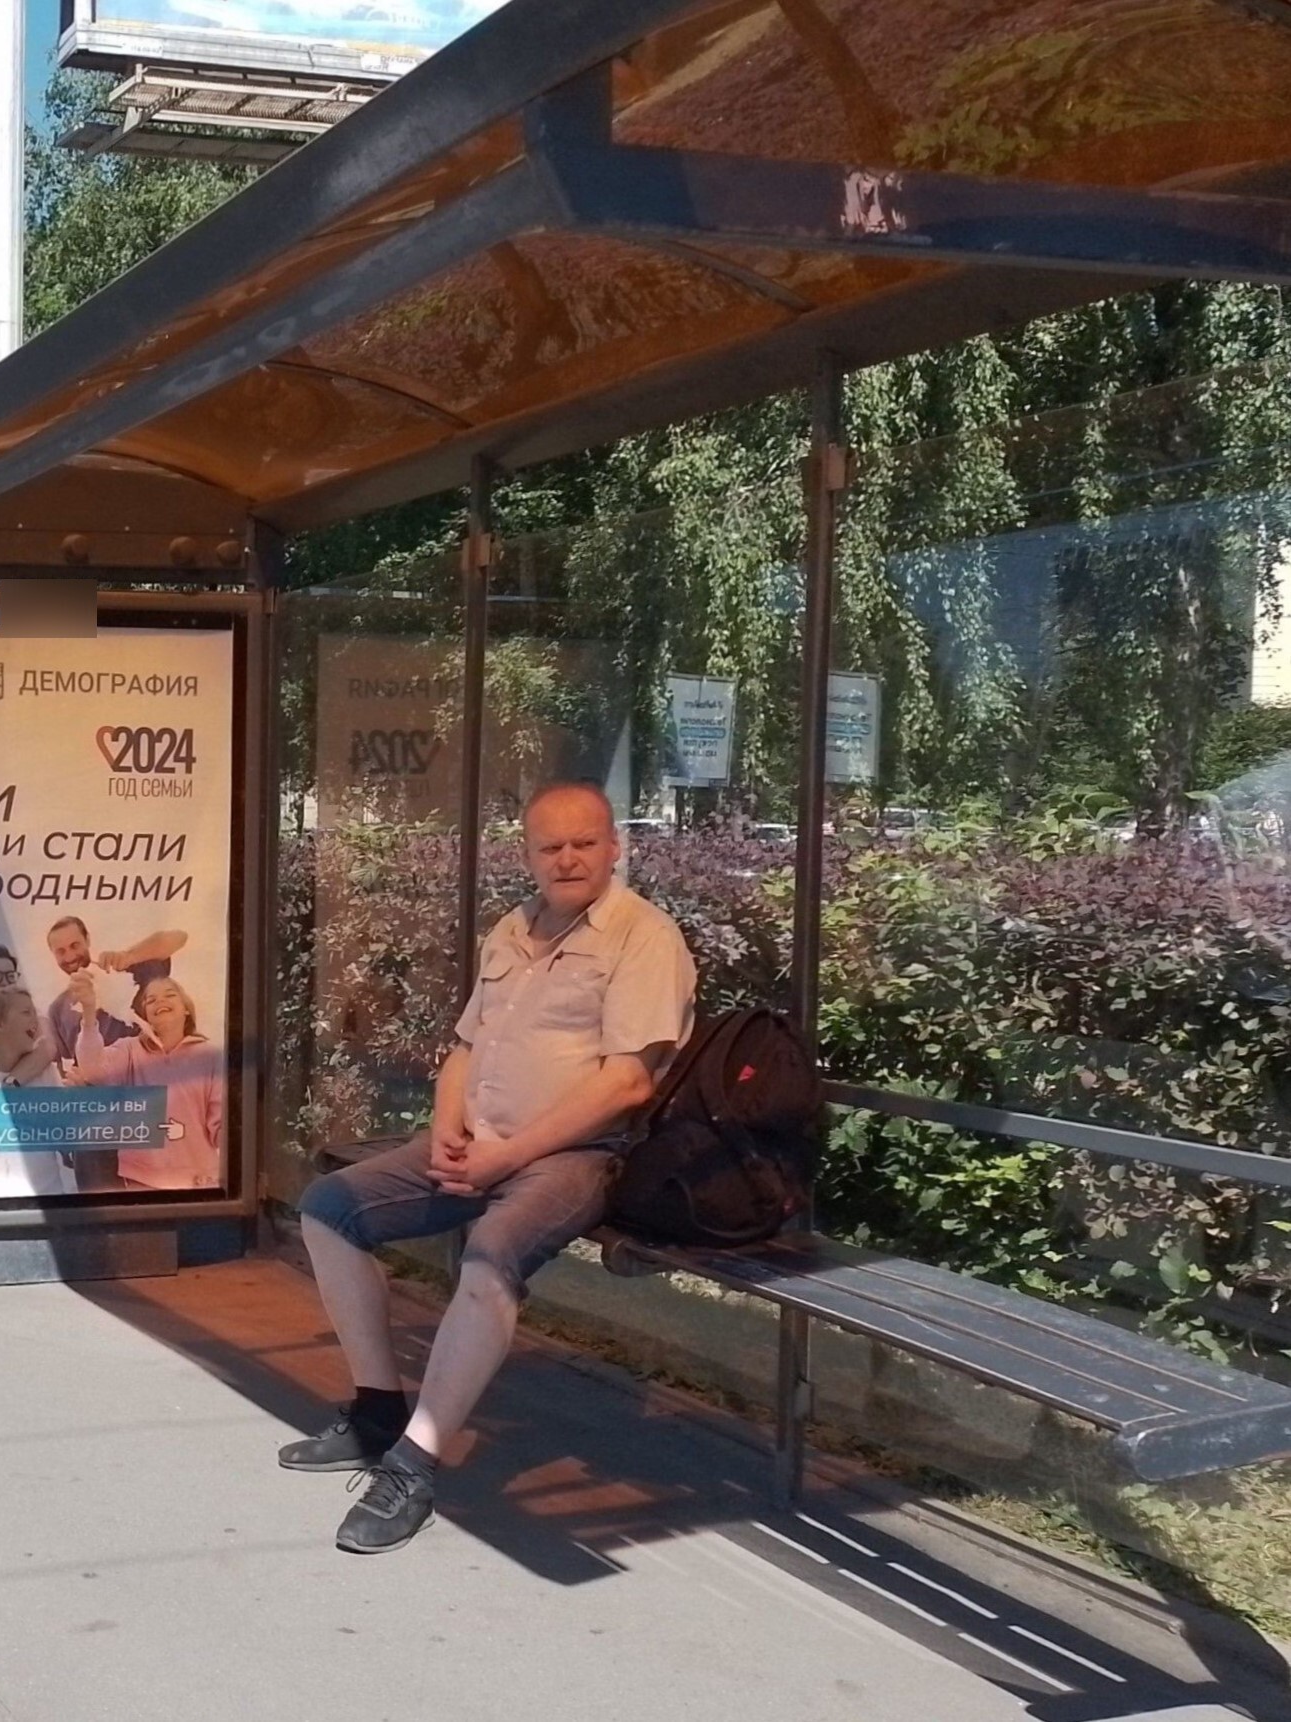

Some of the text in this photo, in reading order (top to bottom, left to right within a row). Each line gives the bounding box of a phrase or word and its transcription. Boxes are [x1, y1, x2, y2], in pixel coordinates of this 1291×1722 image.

[19, 670, 198, 696] ДЕМОГРАФИЯ
[111, 726, 197, 774] 2024
[42, 831, 187, 861] стали
[0, 1101, 147, 1114] СТАНОВИТЕСЬ И ВЫ
